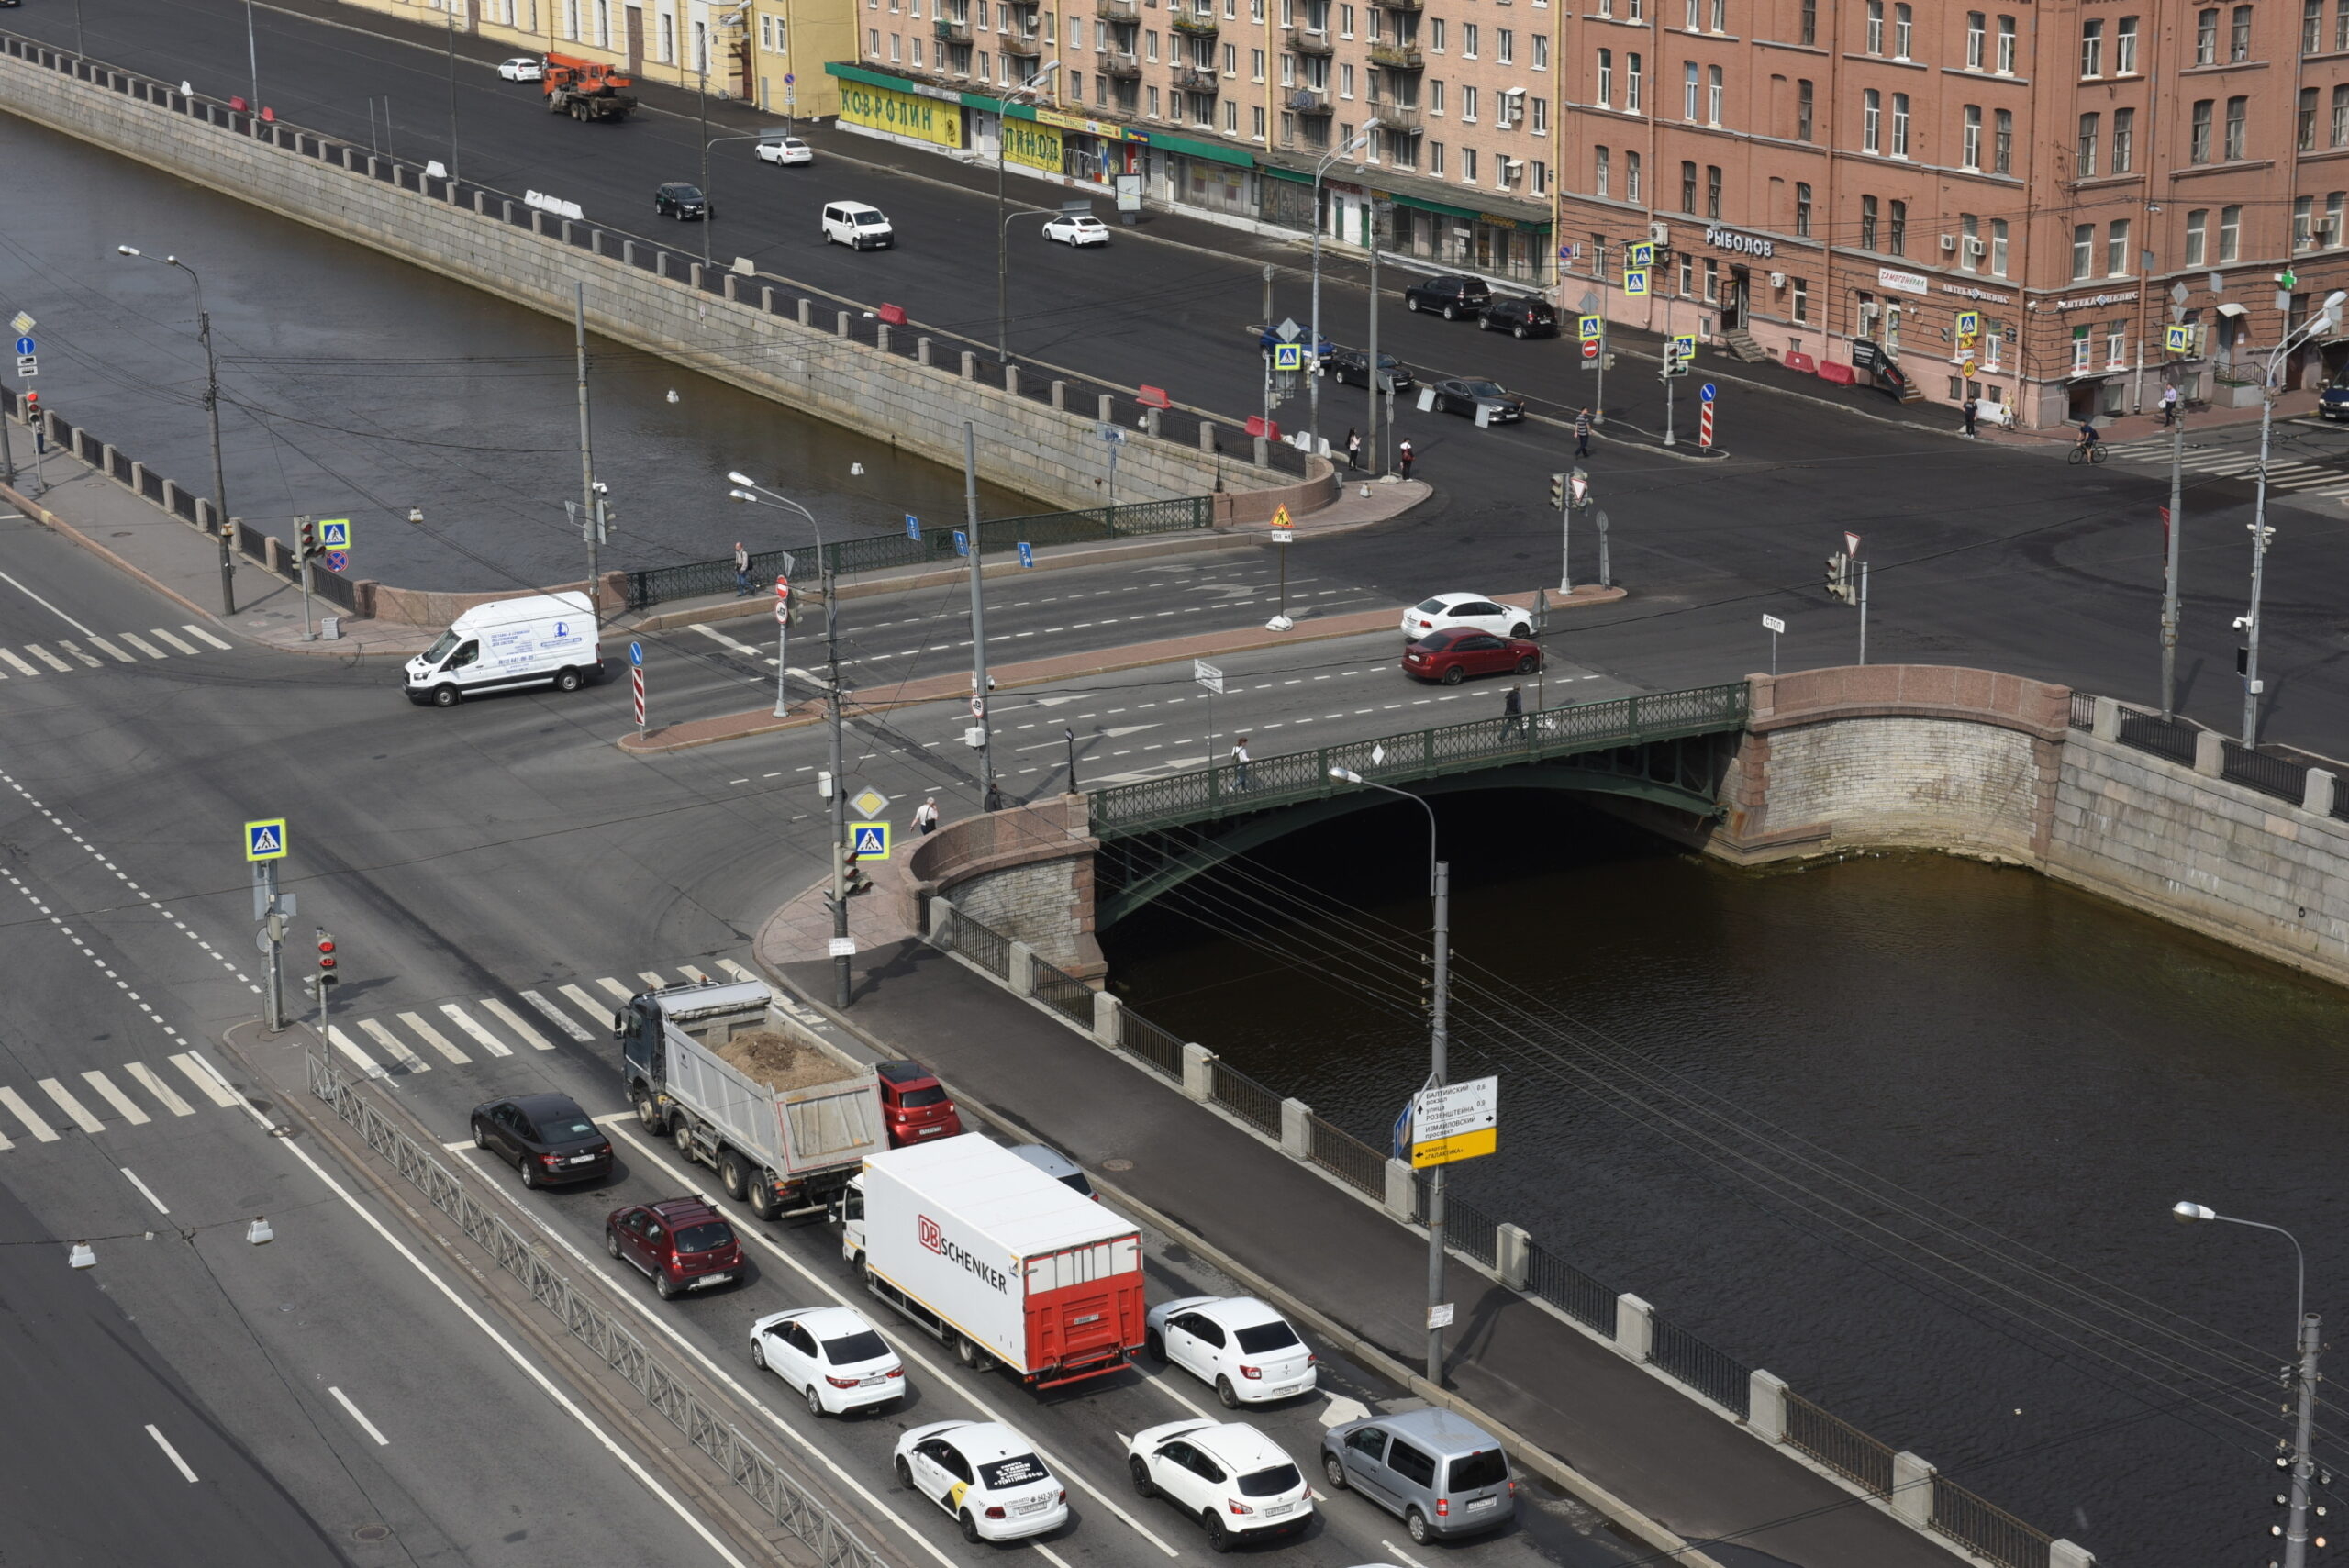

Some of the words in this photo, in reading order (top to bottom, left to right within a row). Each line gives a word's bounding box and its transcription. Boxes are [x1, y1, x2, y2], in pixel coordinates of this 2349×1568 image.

[841, 88, 931, 131] КОВРОЛИН
[1706, 228, 1773, 258] РЫБОЛОВ
[2062, 296, 2097, 308] ПТЕКА
[1765, 617, 1782, 630] СТОП
[1426, 1084, 1469, 1099] БАЛТИЙСКИЙ
[1426, 1106, 1445, 1114] улица
[1426, 1106, 1475, 1121] РОЗЕНШТЕЙНА
[1425, 1116, 1476, 1133] ИЗМАЙЛОВСКИЙ
[1425, 1129, 1453, 1140] проспект
[921, 1219, 939, 1249] DB
[941, 1237, 1008, 1295] SCHENKER
